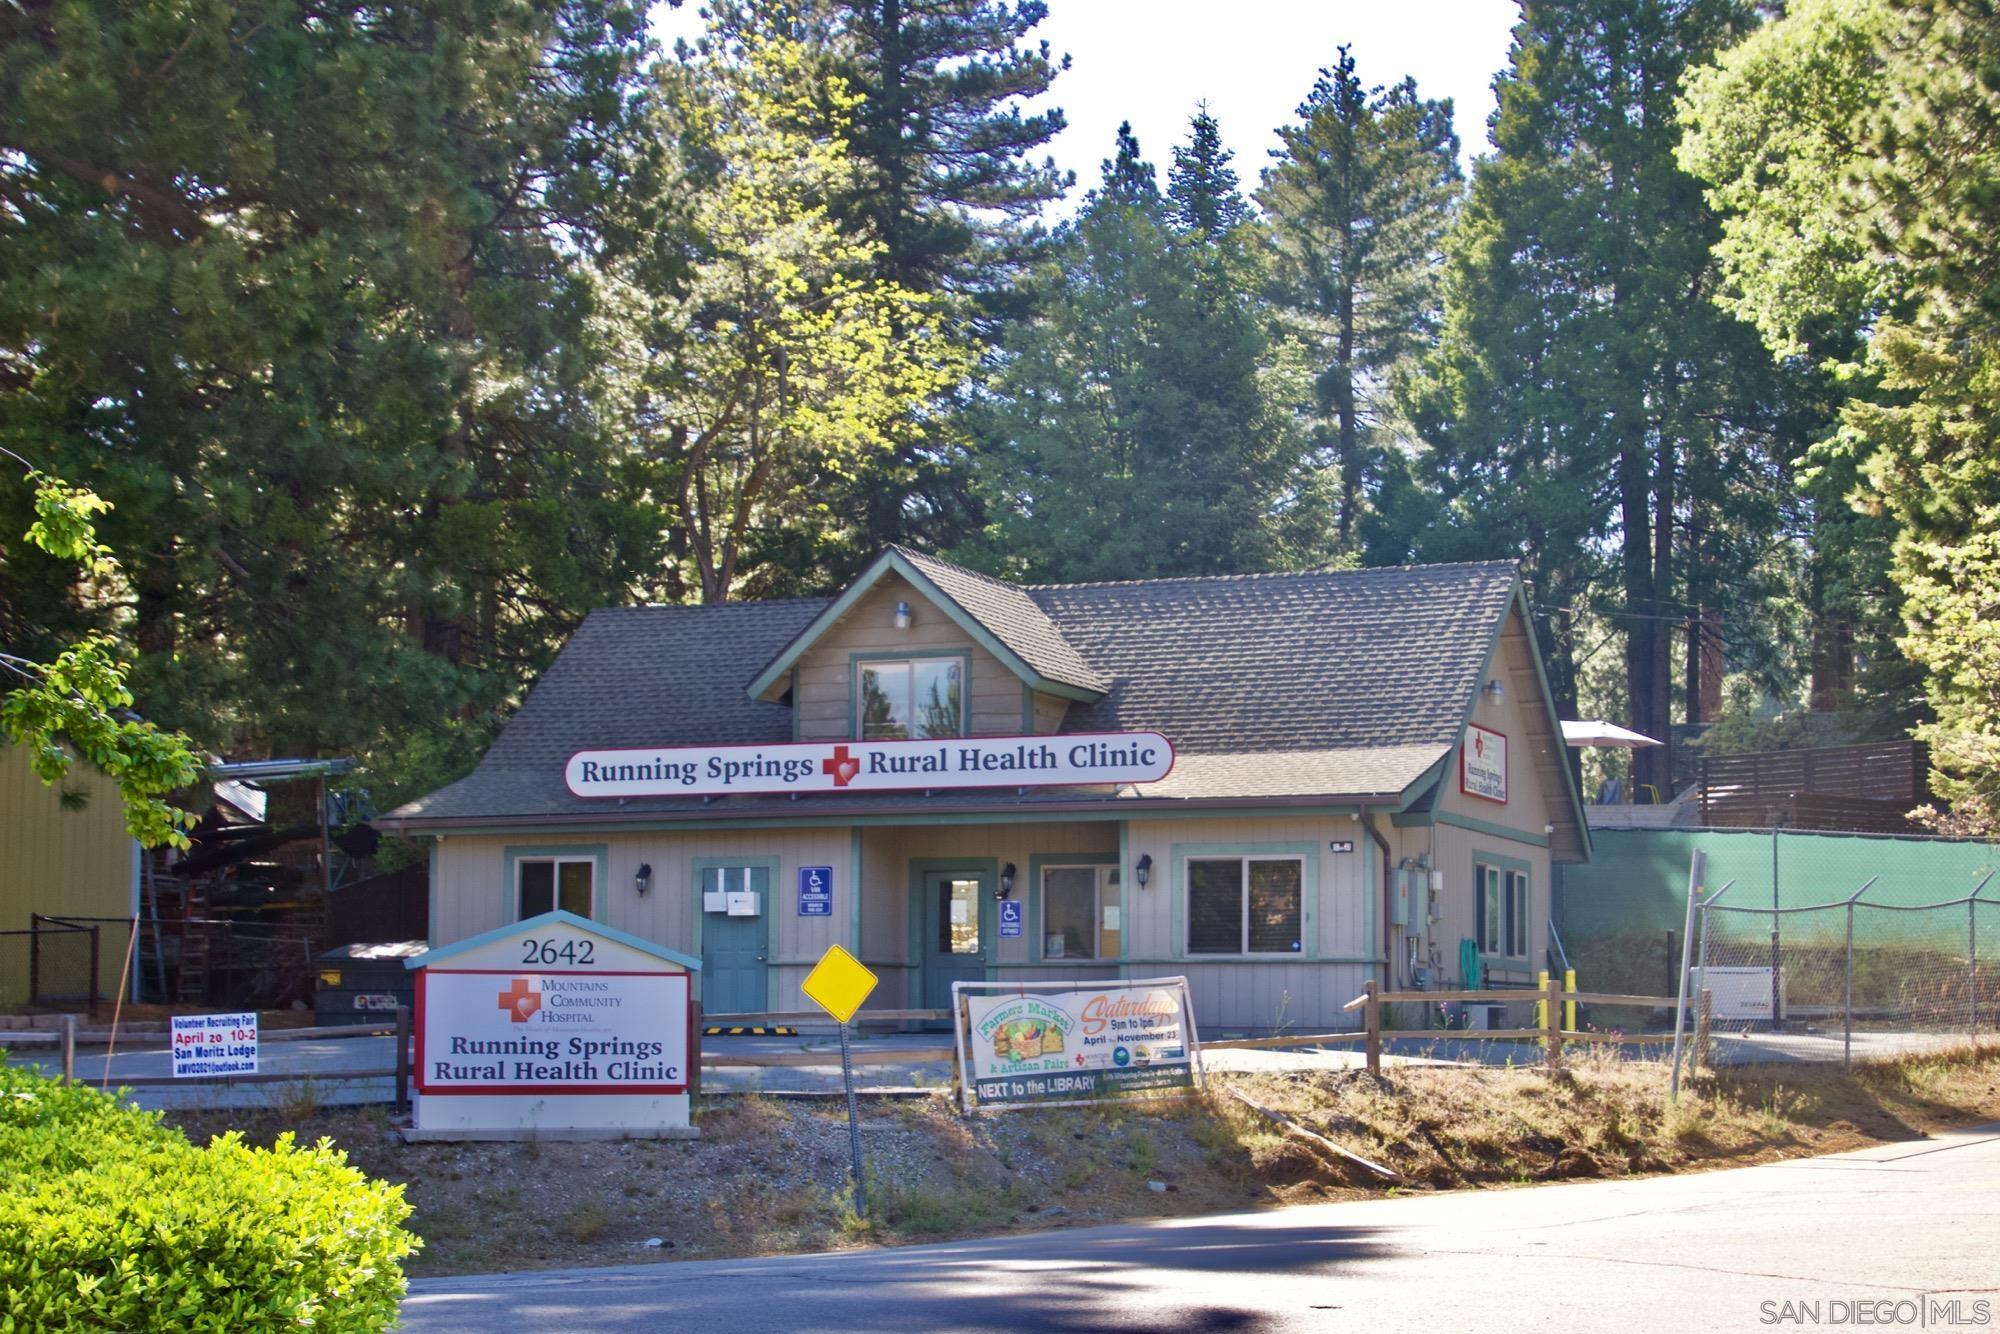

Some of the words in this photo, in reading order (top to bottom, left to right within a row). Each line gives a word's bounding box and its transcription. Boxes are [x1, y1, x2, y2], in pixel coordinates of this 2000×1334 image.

[581, 756, 698, 785] Running
[706, 753, 814, 784] Springs
[868, 748, 948, 774] Rural
[958, 745, 1058, 772] Health
[1068, 742, 1157, 768] Clinic
[522, 939, 594, 965] 2642
[174, 1019, 205, 1029] Volunteer
[207, 1016, 240, 1028] Recruiting
[242, 1015, 255, 1026] Fair
[1028, 1002, 1069, 1030] Market
[1080, 993, 1174, 1035] Saturdays
[1111, 1020, 1127, 1030] 9am
[1129, 1019, 1138, 1029] to
[176, 1032, 204, 1046] April
[209, 1034, 222, 1043] 20
[230, 1029, 256, 1041] 10-2
[1084, 1036, 1106, 1046] April
[1117, 1032, 1164, 1042] November
[1167, 1031, 1177, 1039] 23
[174, 1047, 192, 1059] San
[195, 1046, 225, 1058] Moritz
[228, 1045, 256, 1058] Lodge
[451, 1036, 560, 1059] Running
[569, 1036, 662, 1060] Springs
[434, 1061, 505, 1080] Rural
[514, 1061, 598, 1080] Health
[607, 1061, 678, 1080] Clinic
[1000, 1062, 1040, 1073] Artisan
[978, 1083, 1008, 1098] NEXT
[1011, 1081, 1024, 1095] to
[1027, 1080, 1045, 1094] the
[1047, 1075, 1096, 1092] LIBRARY
